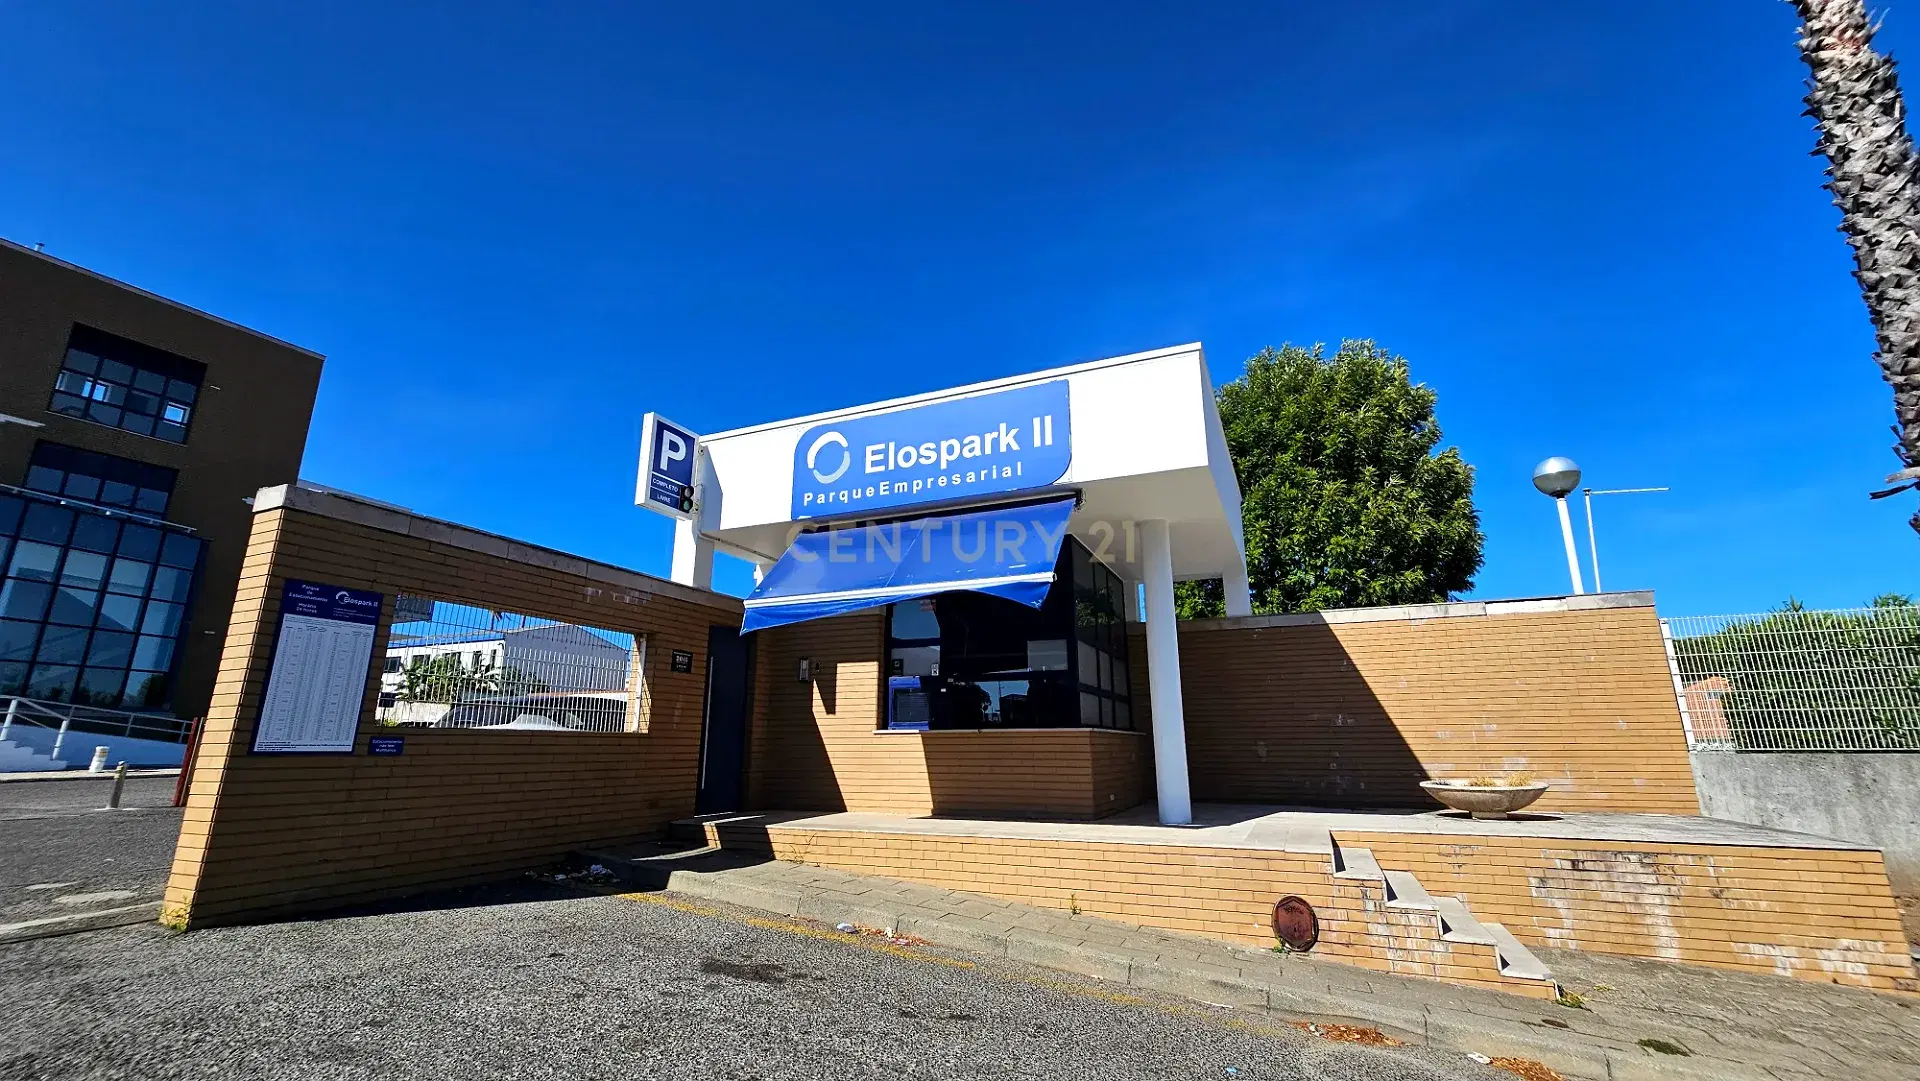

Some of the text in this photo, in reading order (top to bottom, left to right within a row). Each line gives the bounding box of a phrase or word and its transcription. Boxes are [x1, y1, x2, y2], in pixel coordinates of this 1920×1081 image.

[660, 429, 687, 471] P
[864, 415, 1053, 474] Elospark II
[652, 478, 679, 493] COMPLETO
[657, 493, 671, 503] LIVRE
[343, 596, 373, 607] Elospark
